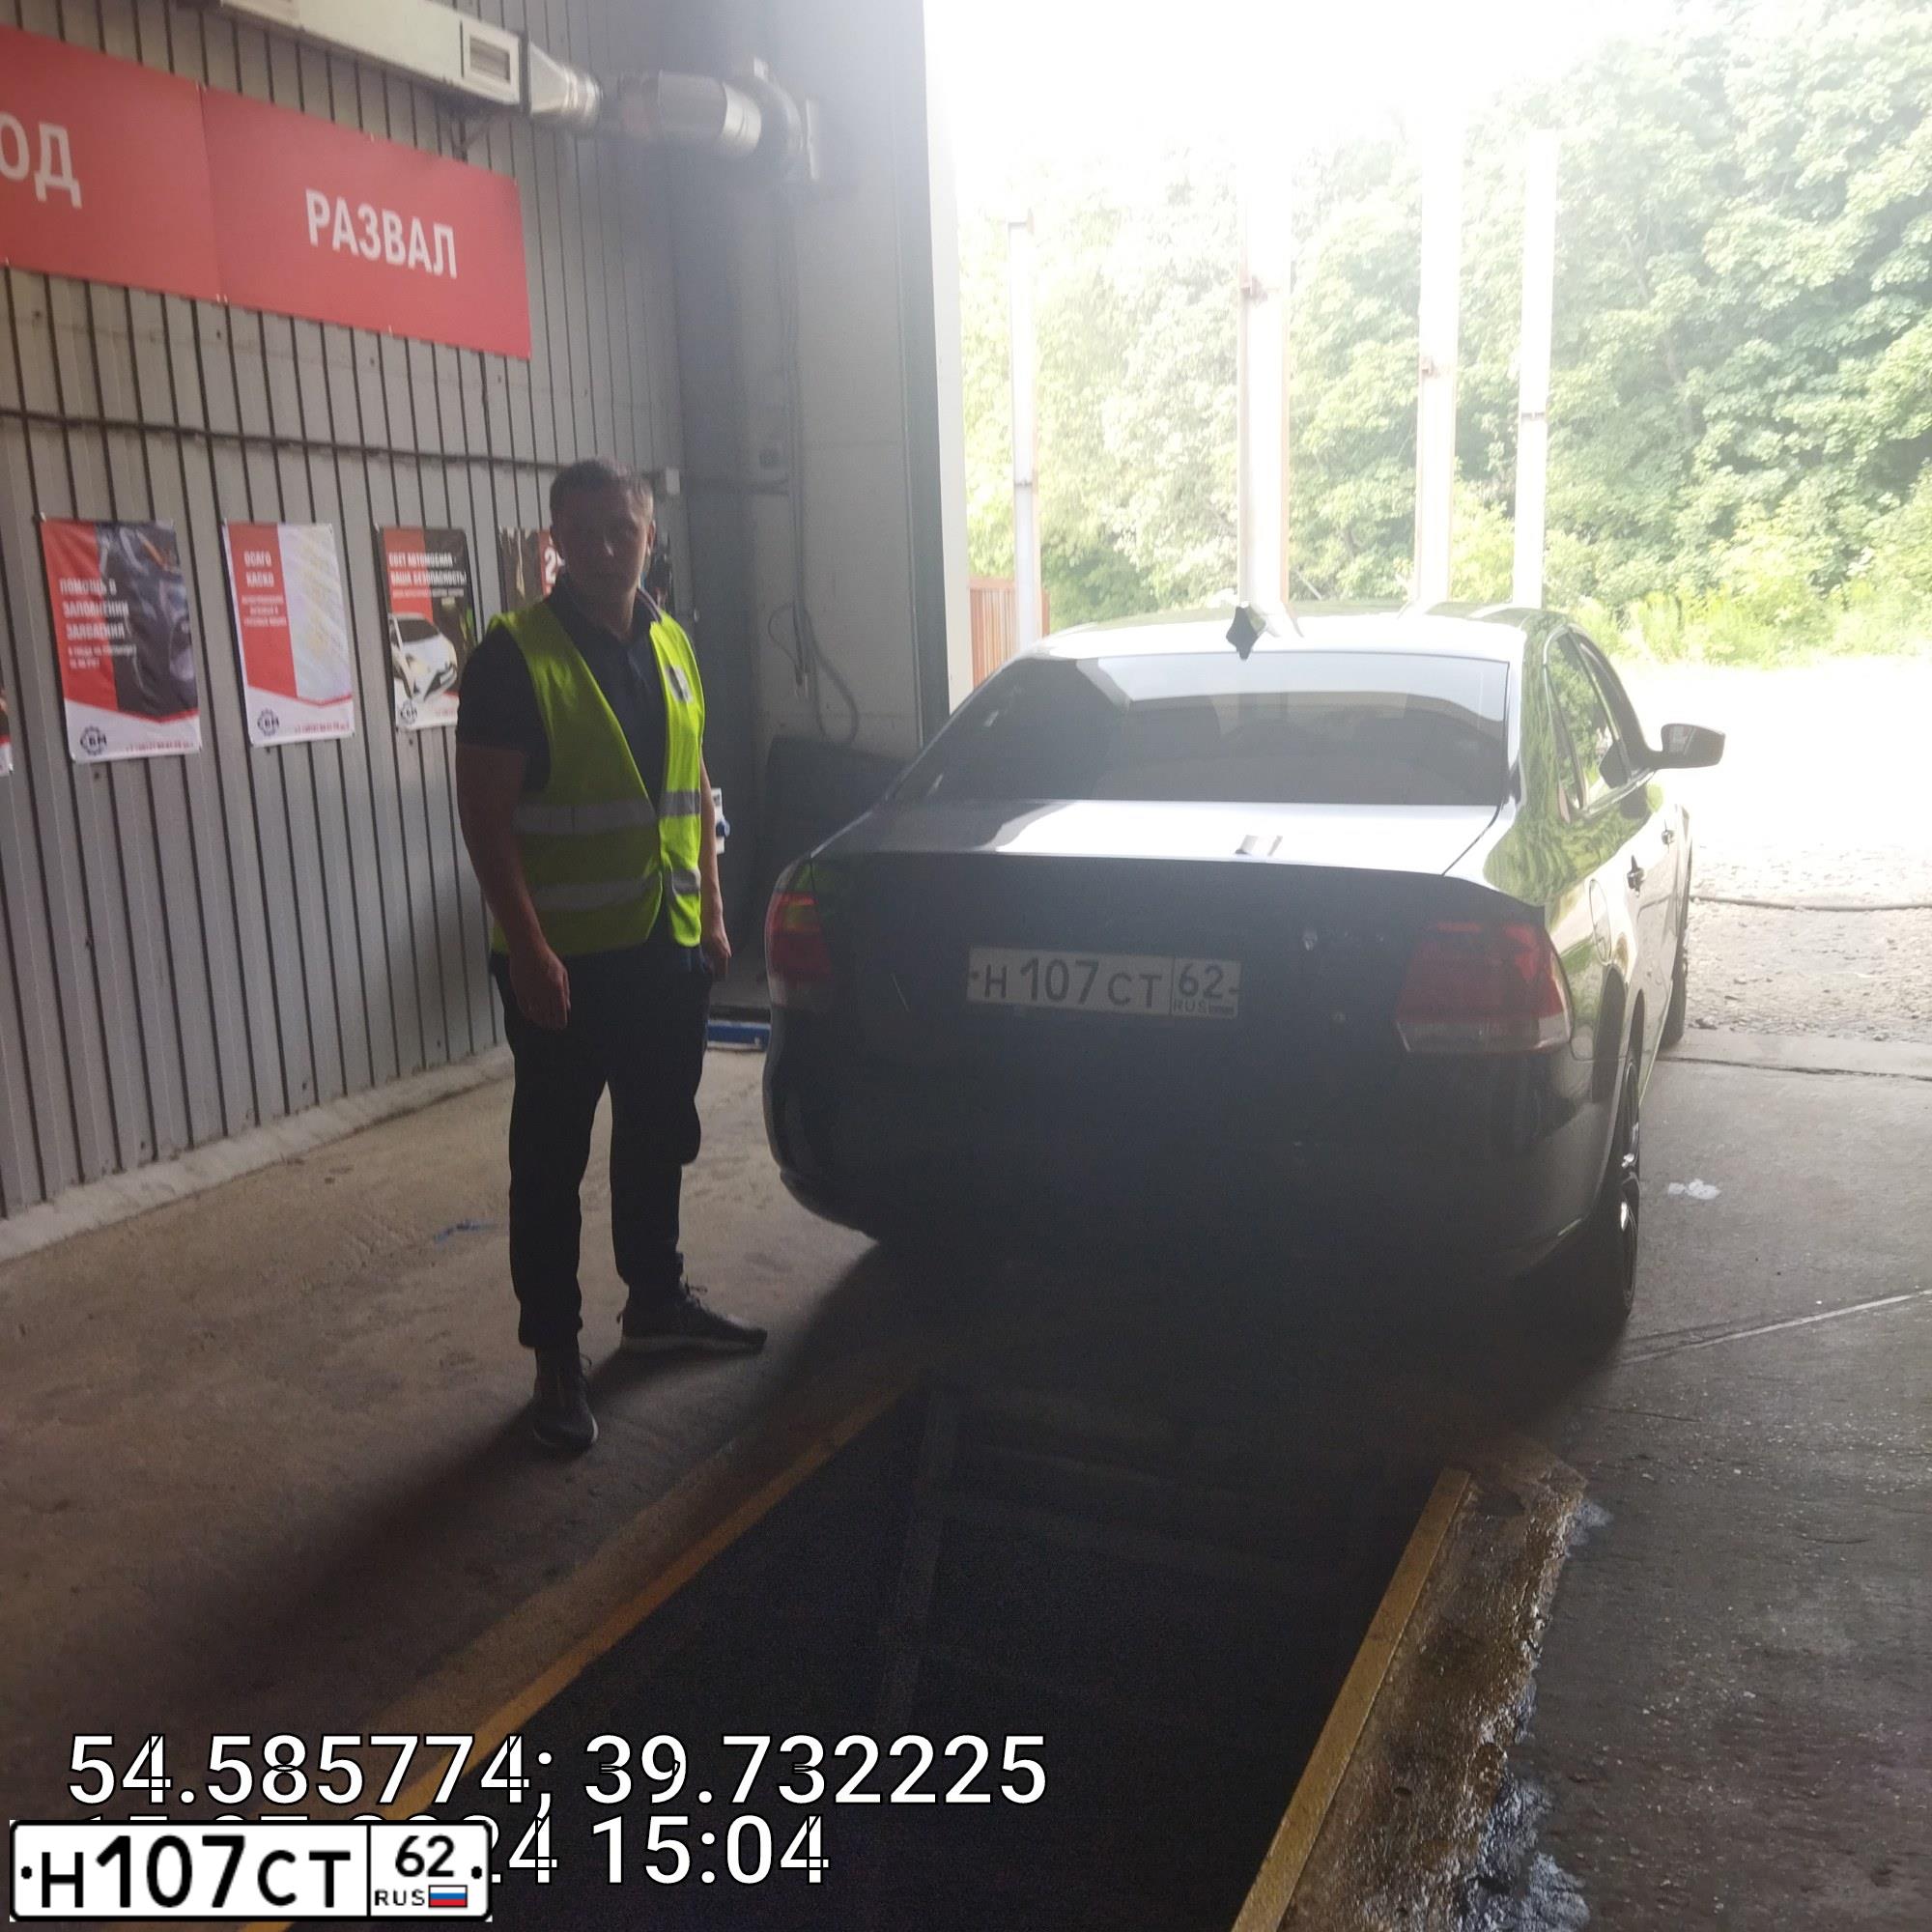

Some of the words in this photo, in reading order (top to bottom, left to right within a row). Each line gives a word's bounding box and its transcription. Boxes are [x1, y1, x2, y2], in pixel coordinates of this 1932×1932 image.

[0, 111, 83, 210] ОД
[305, 188, 457, 279] РАЗВАЛ
[1179, 962, 1224, 999] 62
